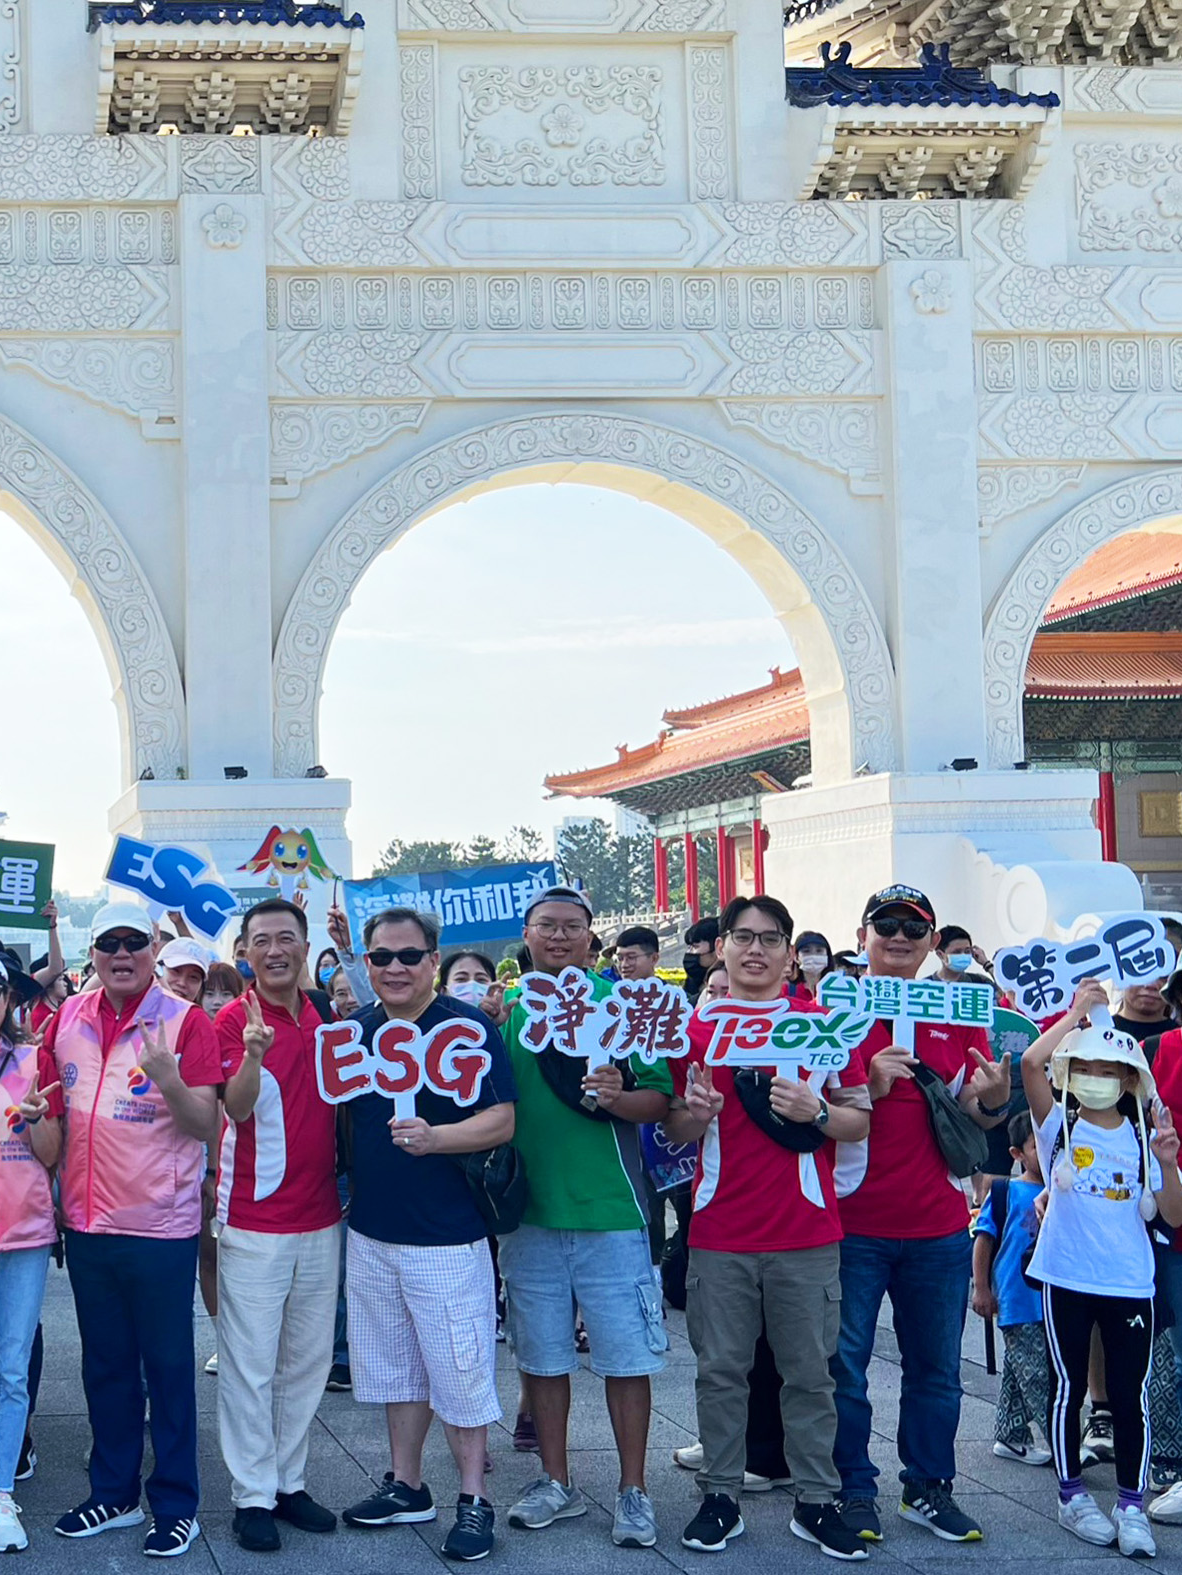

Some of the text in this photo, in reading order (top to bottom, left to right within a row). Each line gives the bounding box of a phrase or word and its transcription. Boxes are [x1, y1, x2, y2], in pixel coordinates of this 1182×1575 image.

[106, 836, 237, 939] ESG
[821, 974, 990, 1024] 台灣空運
[1001, 919, 1166, 1012] 第二屆
[524, 971, 688, 1060] 淨灘
[320, 1022, 487, 1101] ESG
[809, 1053, 844, 1066] TEC
